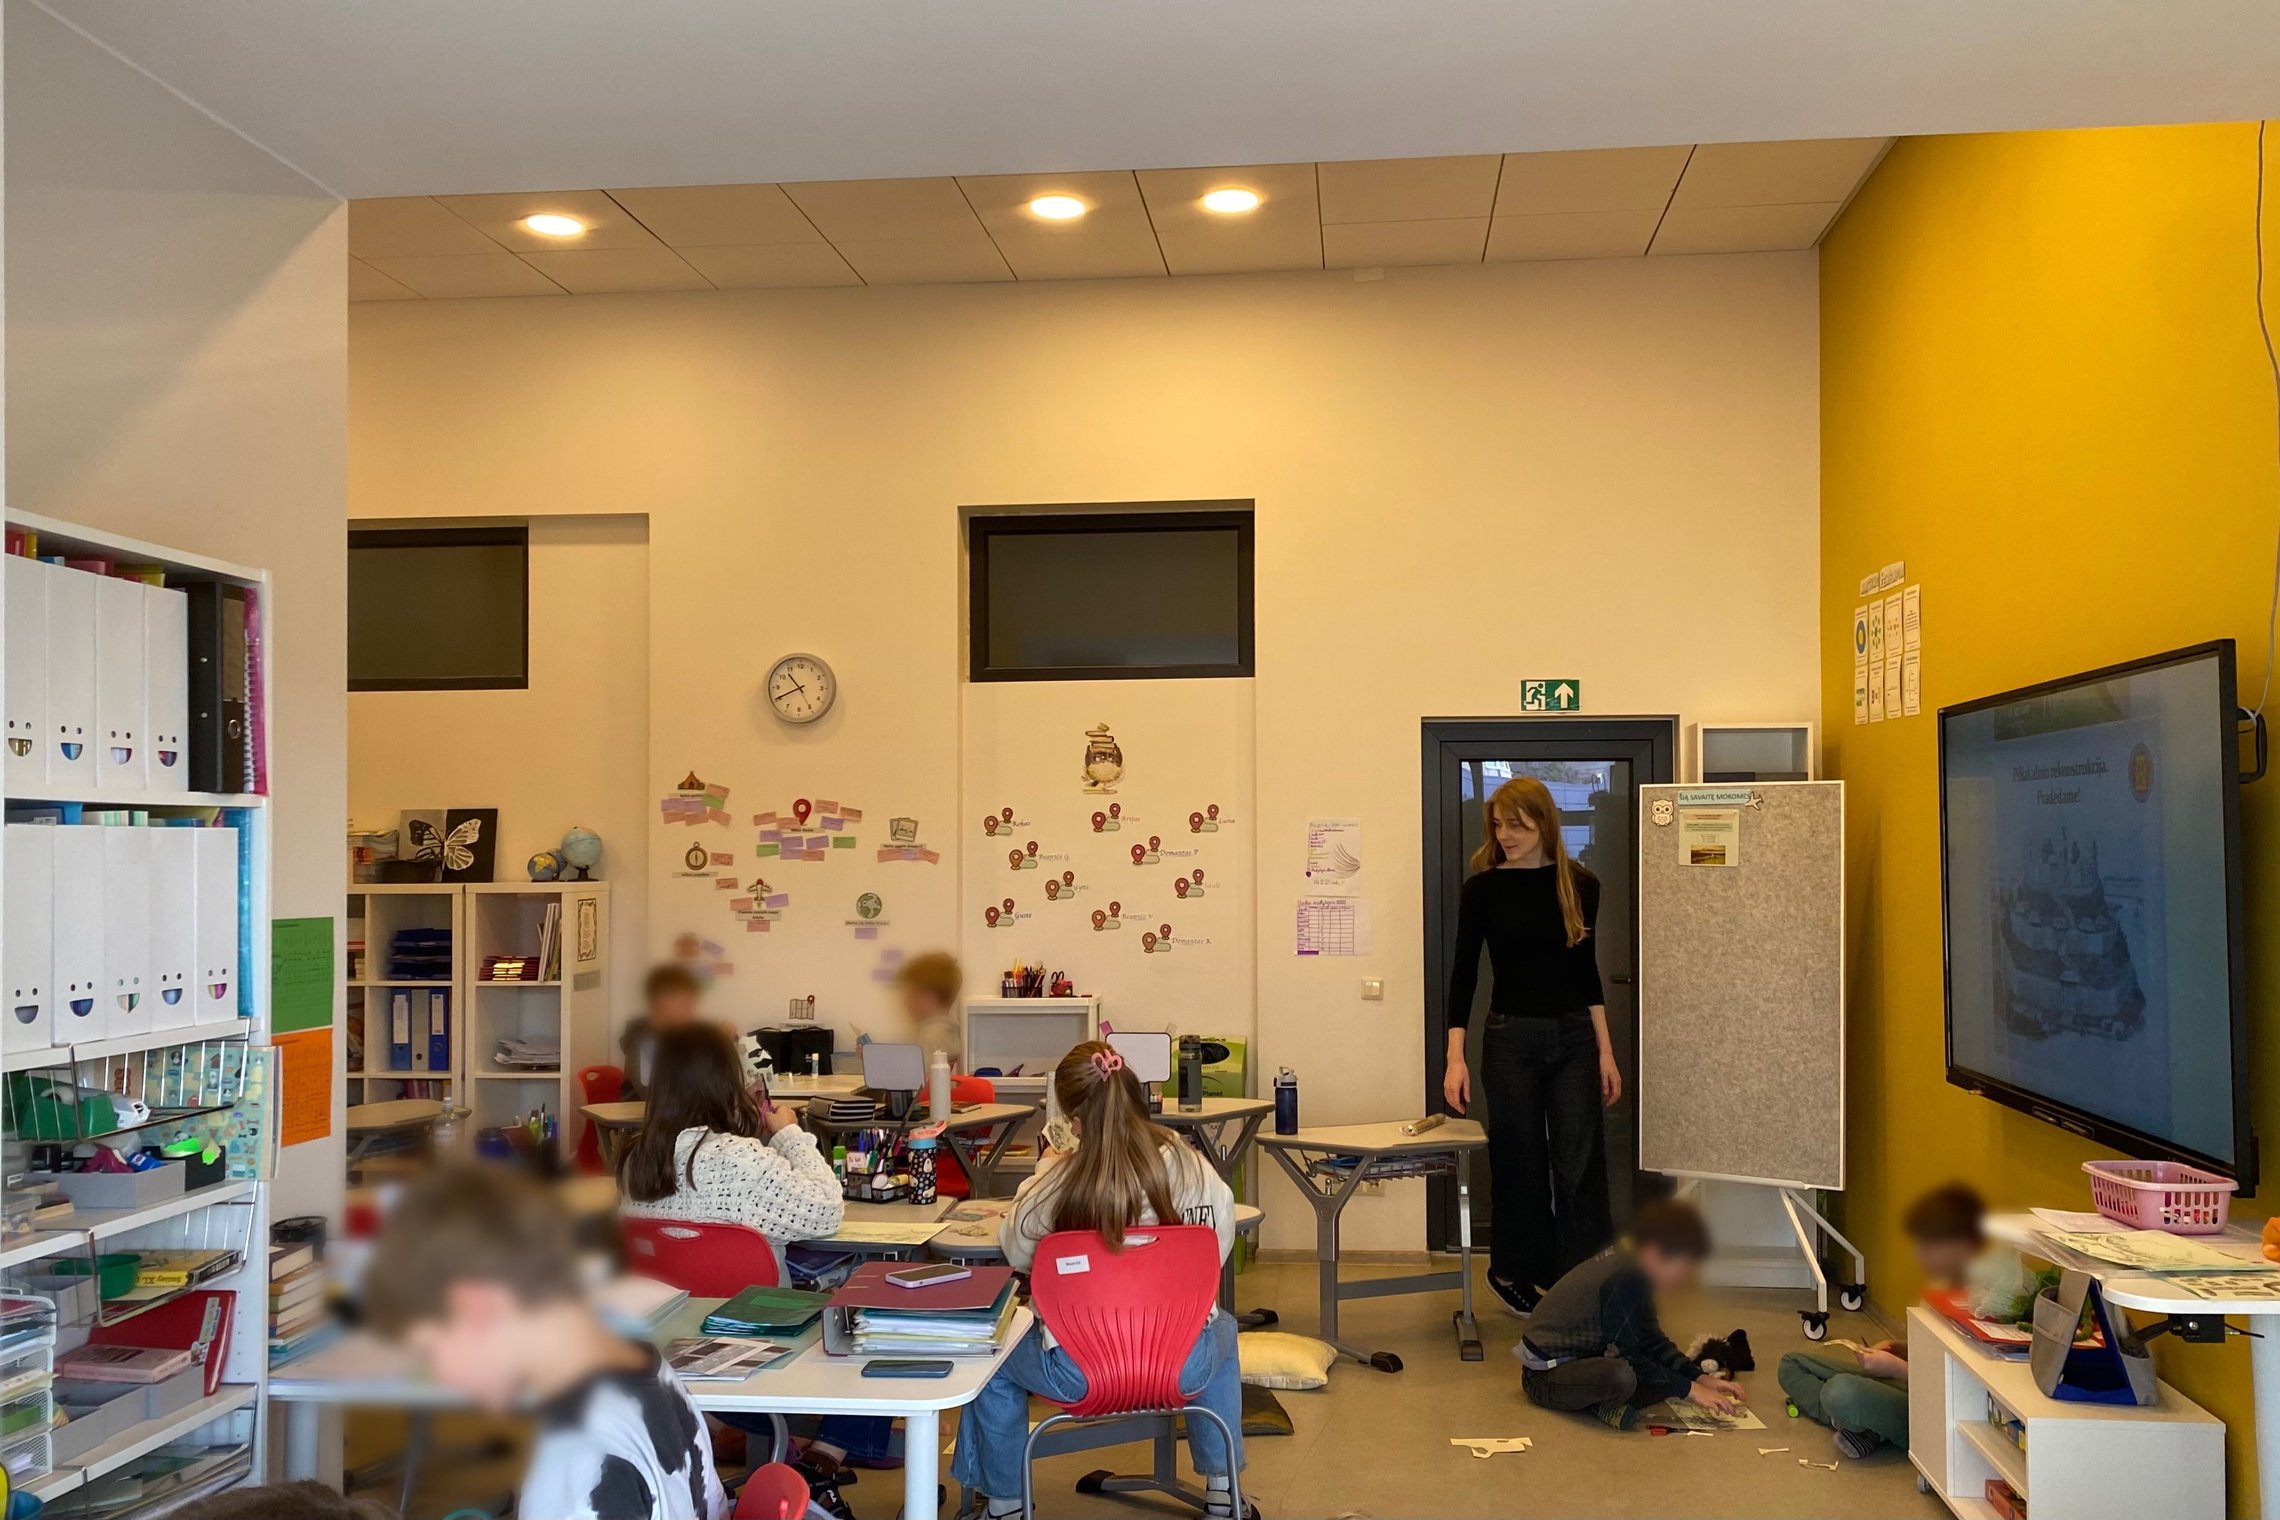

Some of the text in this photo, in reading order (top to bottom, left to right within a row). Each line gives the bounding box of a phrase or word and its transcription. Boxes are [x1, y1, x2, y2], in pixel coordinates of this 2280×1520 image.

[1679, 792, 1689, 801] ŠIĄ
[1690, 793, 1715, 801] SAVAITĘ
[2037, 786, 2081, 806] Pradedame!
[142, 1277, 155, 1285] XL
